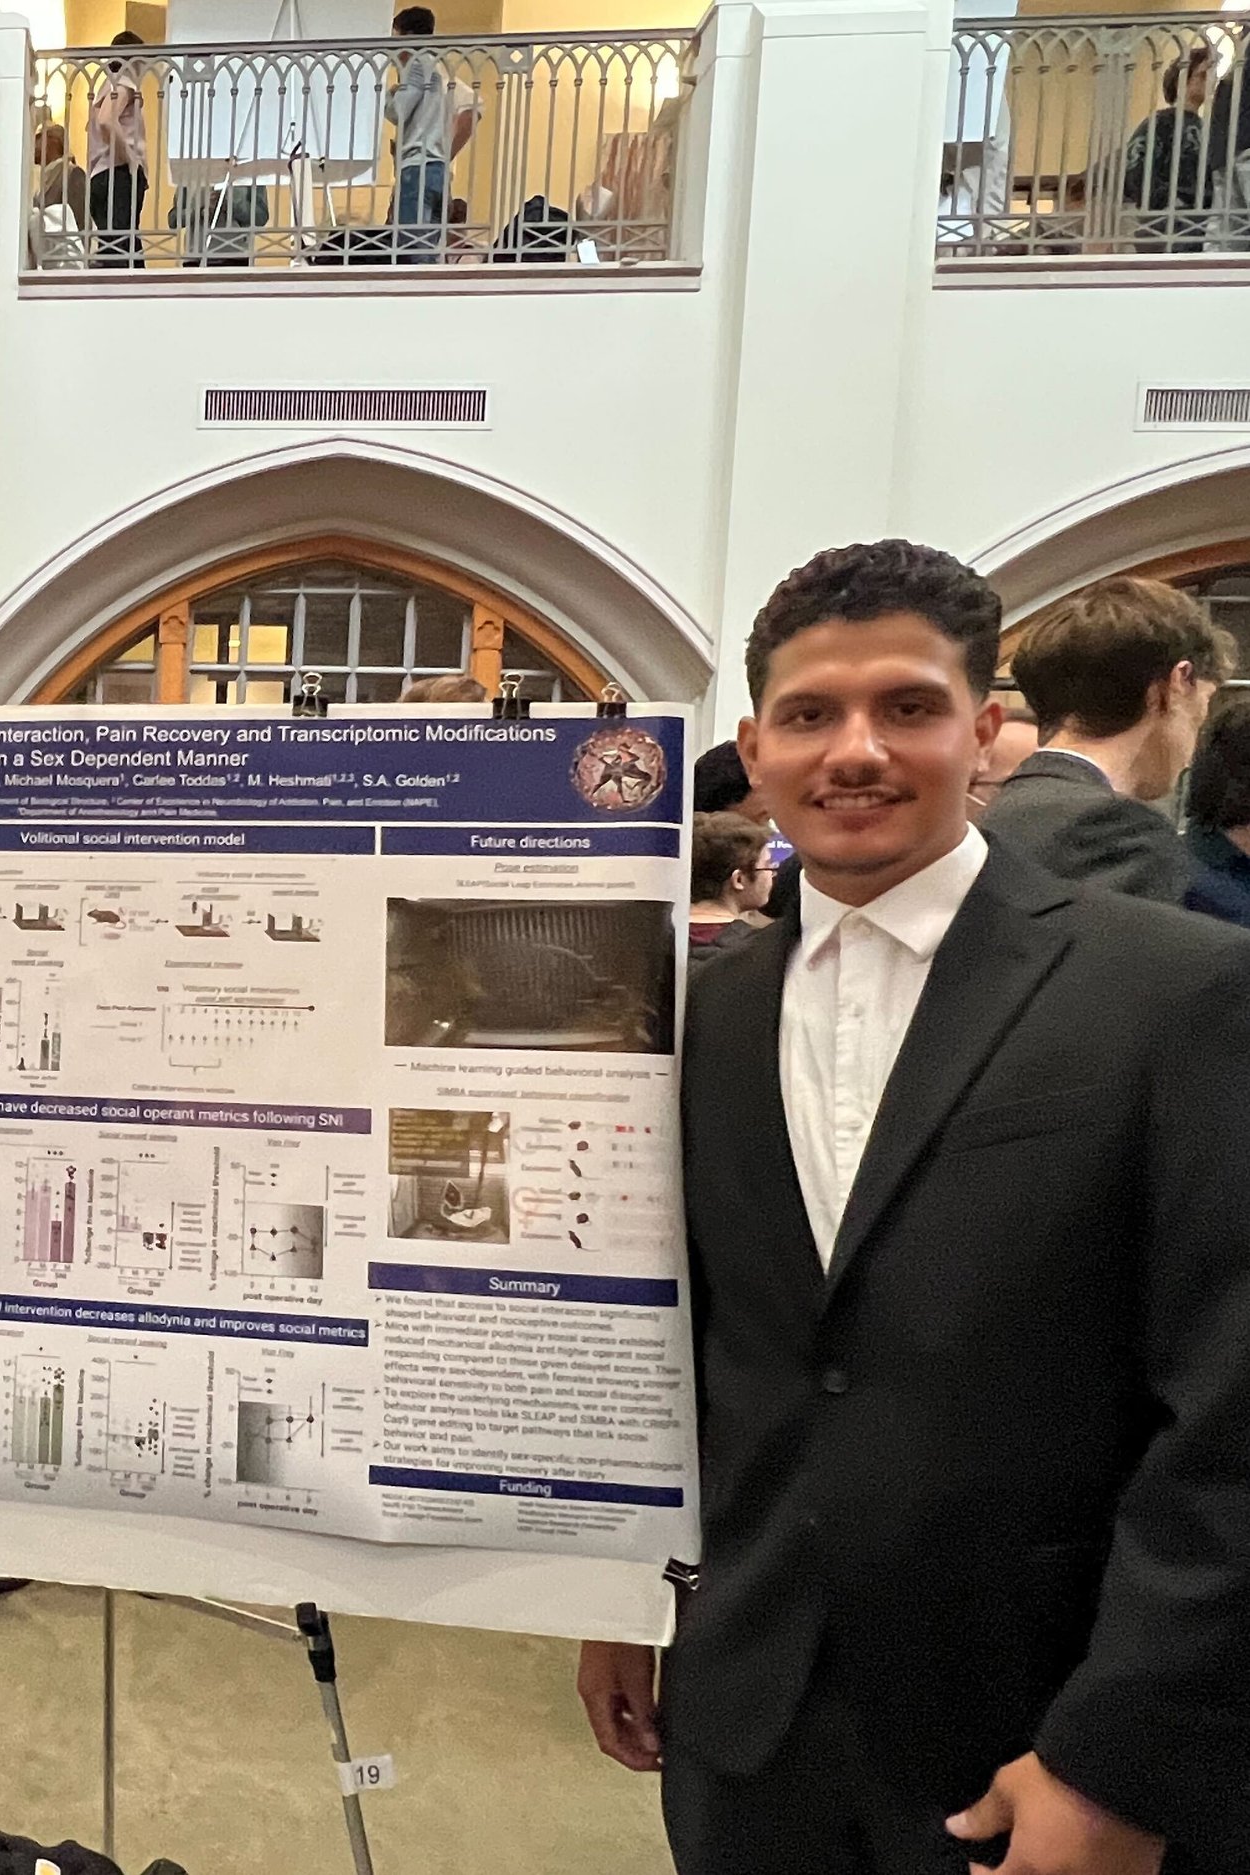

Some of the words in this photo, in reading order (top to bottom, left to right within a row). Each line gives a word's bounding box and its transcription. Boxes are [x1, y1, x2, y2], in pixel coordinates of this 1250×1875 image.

[96, 726, 137, 743] Pain
[143, 726, 230, 746] Recovery
[236, 726, 272, 742] and
[277, 725, 420, 746] Transcriptomic
[425, 725, 557, 742] Modifications
[13, 753, 24, 767] a
[30, 750, 65, 766] Sex
[70, 750, 172, 769] Dependent
[177, 750, 249, 767] Manner
[4, 774, 53, 787] Michael
[20, 831, 80, 845] Volitional
[83, 831, 121, 845] social
[124, 832, 200, 845] intervention
[203, 832, 245, 846] model
[470, 835, 516, 849] Future
[519, 835, 591, 849] directions
[31, 1100, 98, 1116] decreased
[101, 1103, 140, 1118] social
[143, 1107, 195, 1122] operant
[198, 1109, 250, 1123] metrics
[253, 1111, 316, 1128] following
[318, 1113, 344, 1127] SNI
[488, 1276, 561, 1297] Summary
[4, 1302, 72, 1318] intervention
[75, 1307, 134, 1322] decreases
[138, 1311, 191, 1327] allodynia
[193, 1315, 216, 1329] and
[219, 1317, 276, 1333] improves
[278, 1322, 316, 1336] social
[318, 1325, 366, 1339] metrics
[499, 1479, 552, 1498] Funding
[355, 1764, 380, 1786] 19
